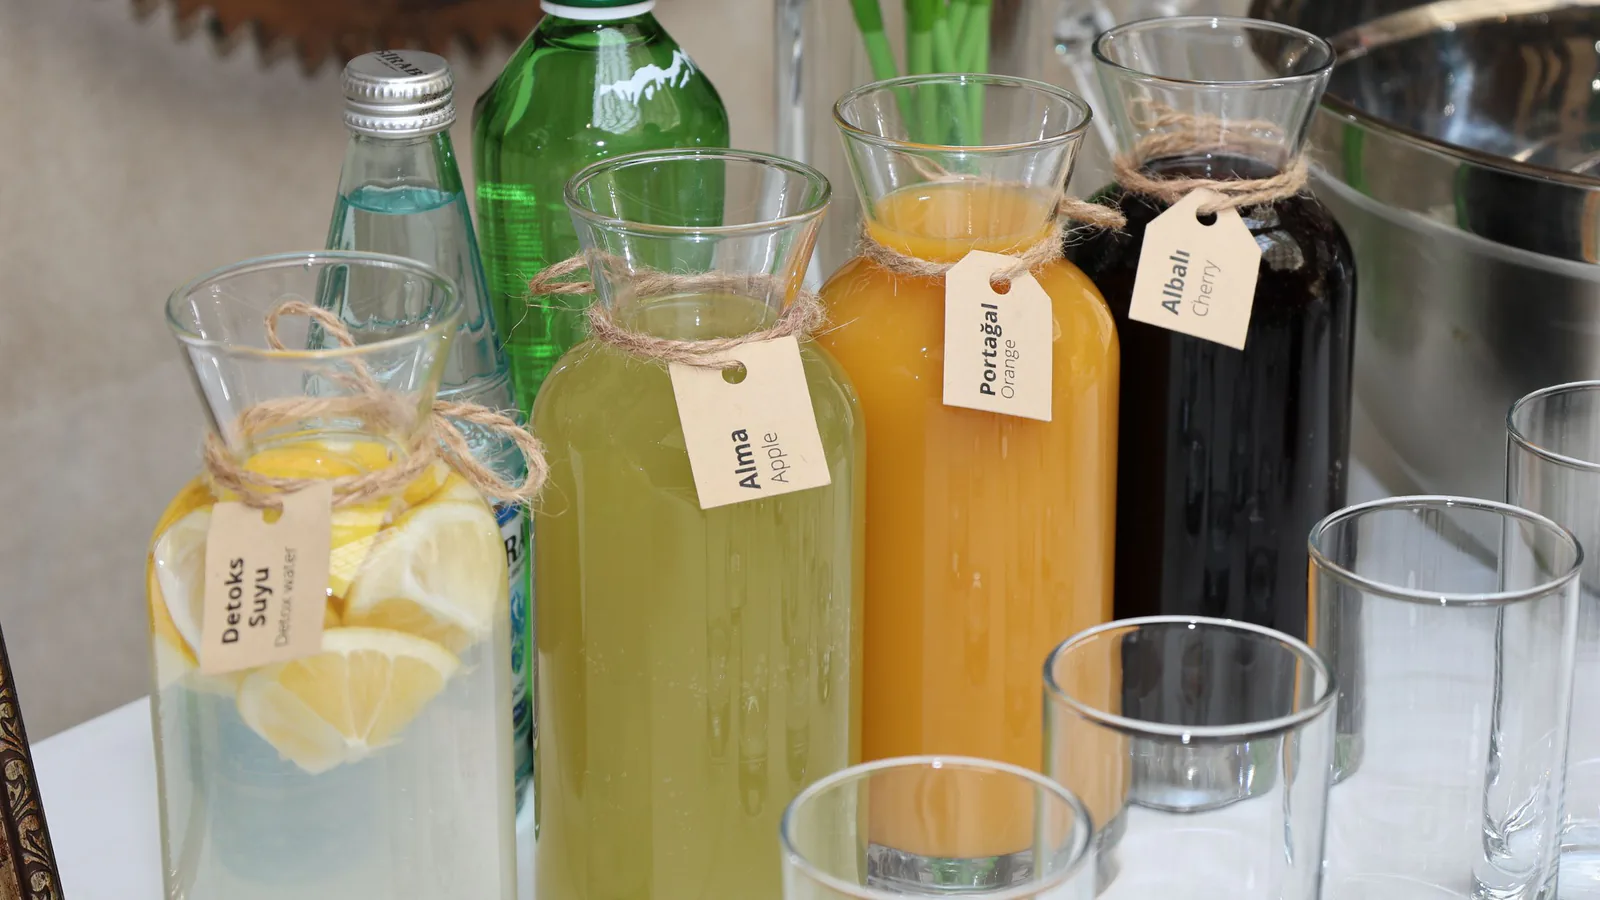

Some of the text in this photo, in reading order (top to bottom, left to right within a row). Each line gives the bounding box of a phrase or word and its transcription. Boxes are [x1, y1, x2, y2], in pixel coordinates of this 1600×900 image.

[1161, 249, 1190, 316] Albalı
[1191, 259, 1222, 317] Cherry
[979, 303, 1003, 396] Portağal
[1000, 339, 1020, 399] Orange
[731, 428, 762, 490] Alma
[761, 432, 791, 483] Apple
[221, 557, 245, 645] Detoks
[248, 567, 274, 627] Suyu
[274, 546, 297, 648] Detox water
